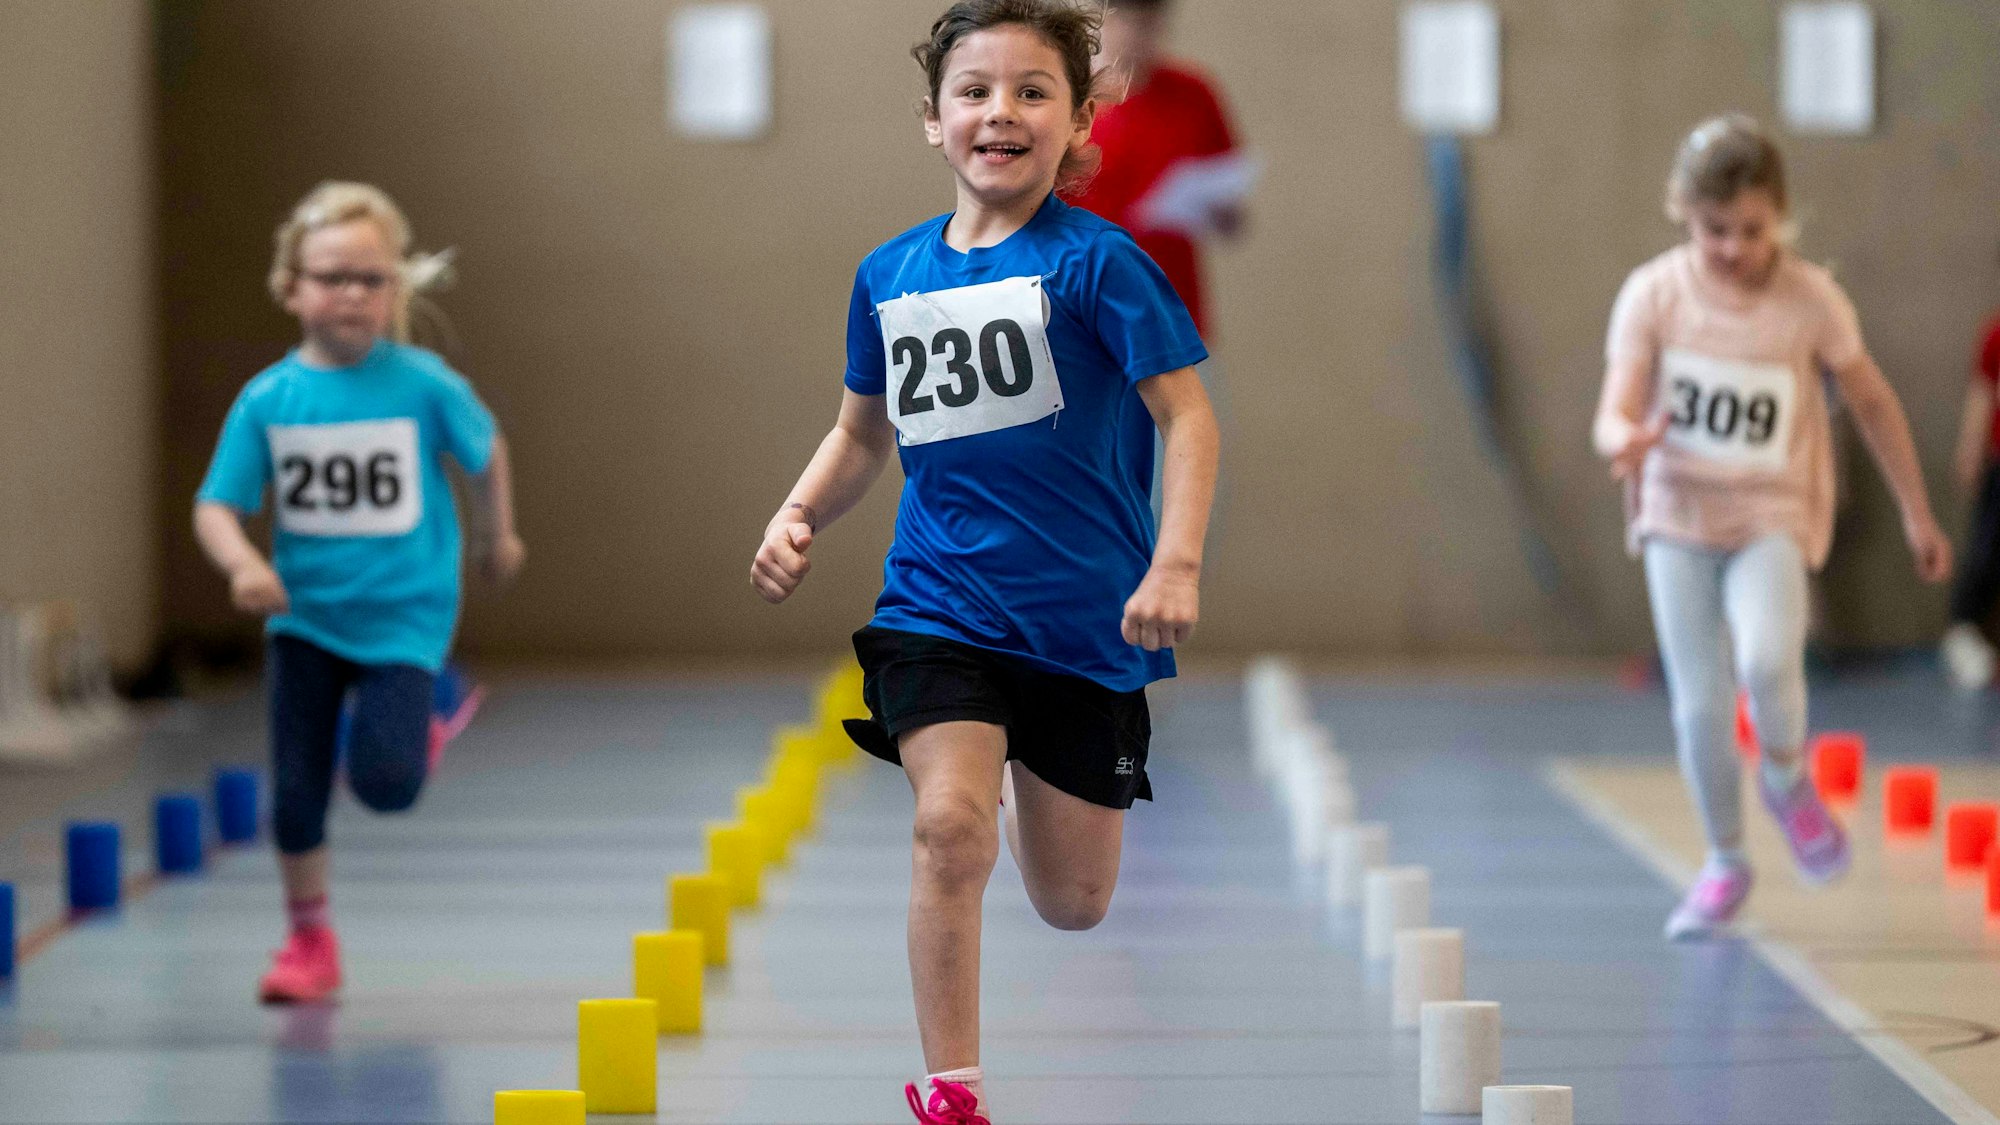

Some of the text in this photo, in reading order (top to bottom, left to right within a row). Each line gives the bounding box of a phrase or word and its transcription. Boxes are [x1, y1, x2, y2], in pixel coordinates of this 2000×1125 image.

[891, 318, 1034, 417] 230
[1669, 378, 1778, 444] 309
[280, 452, 400, 512] 296
